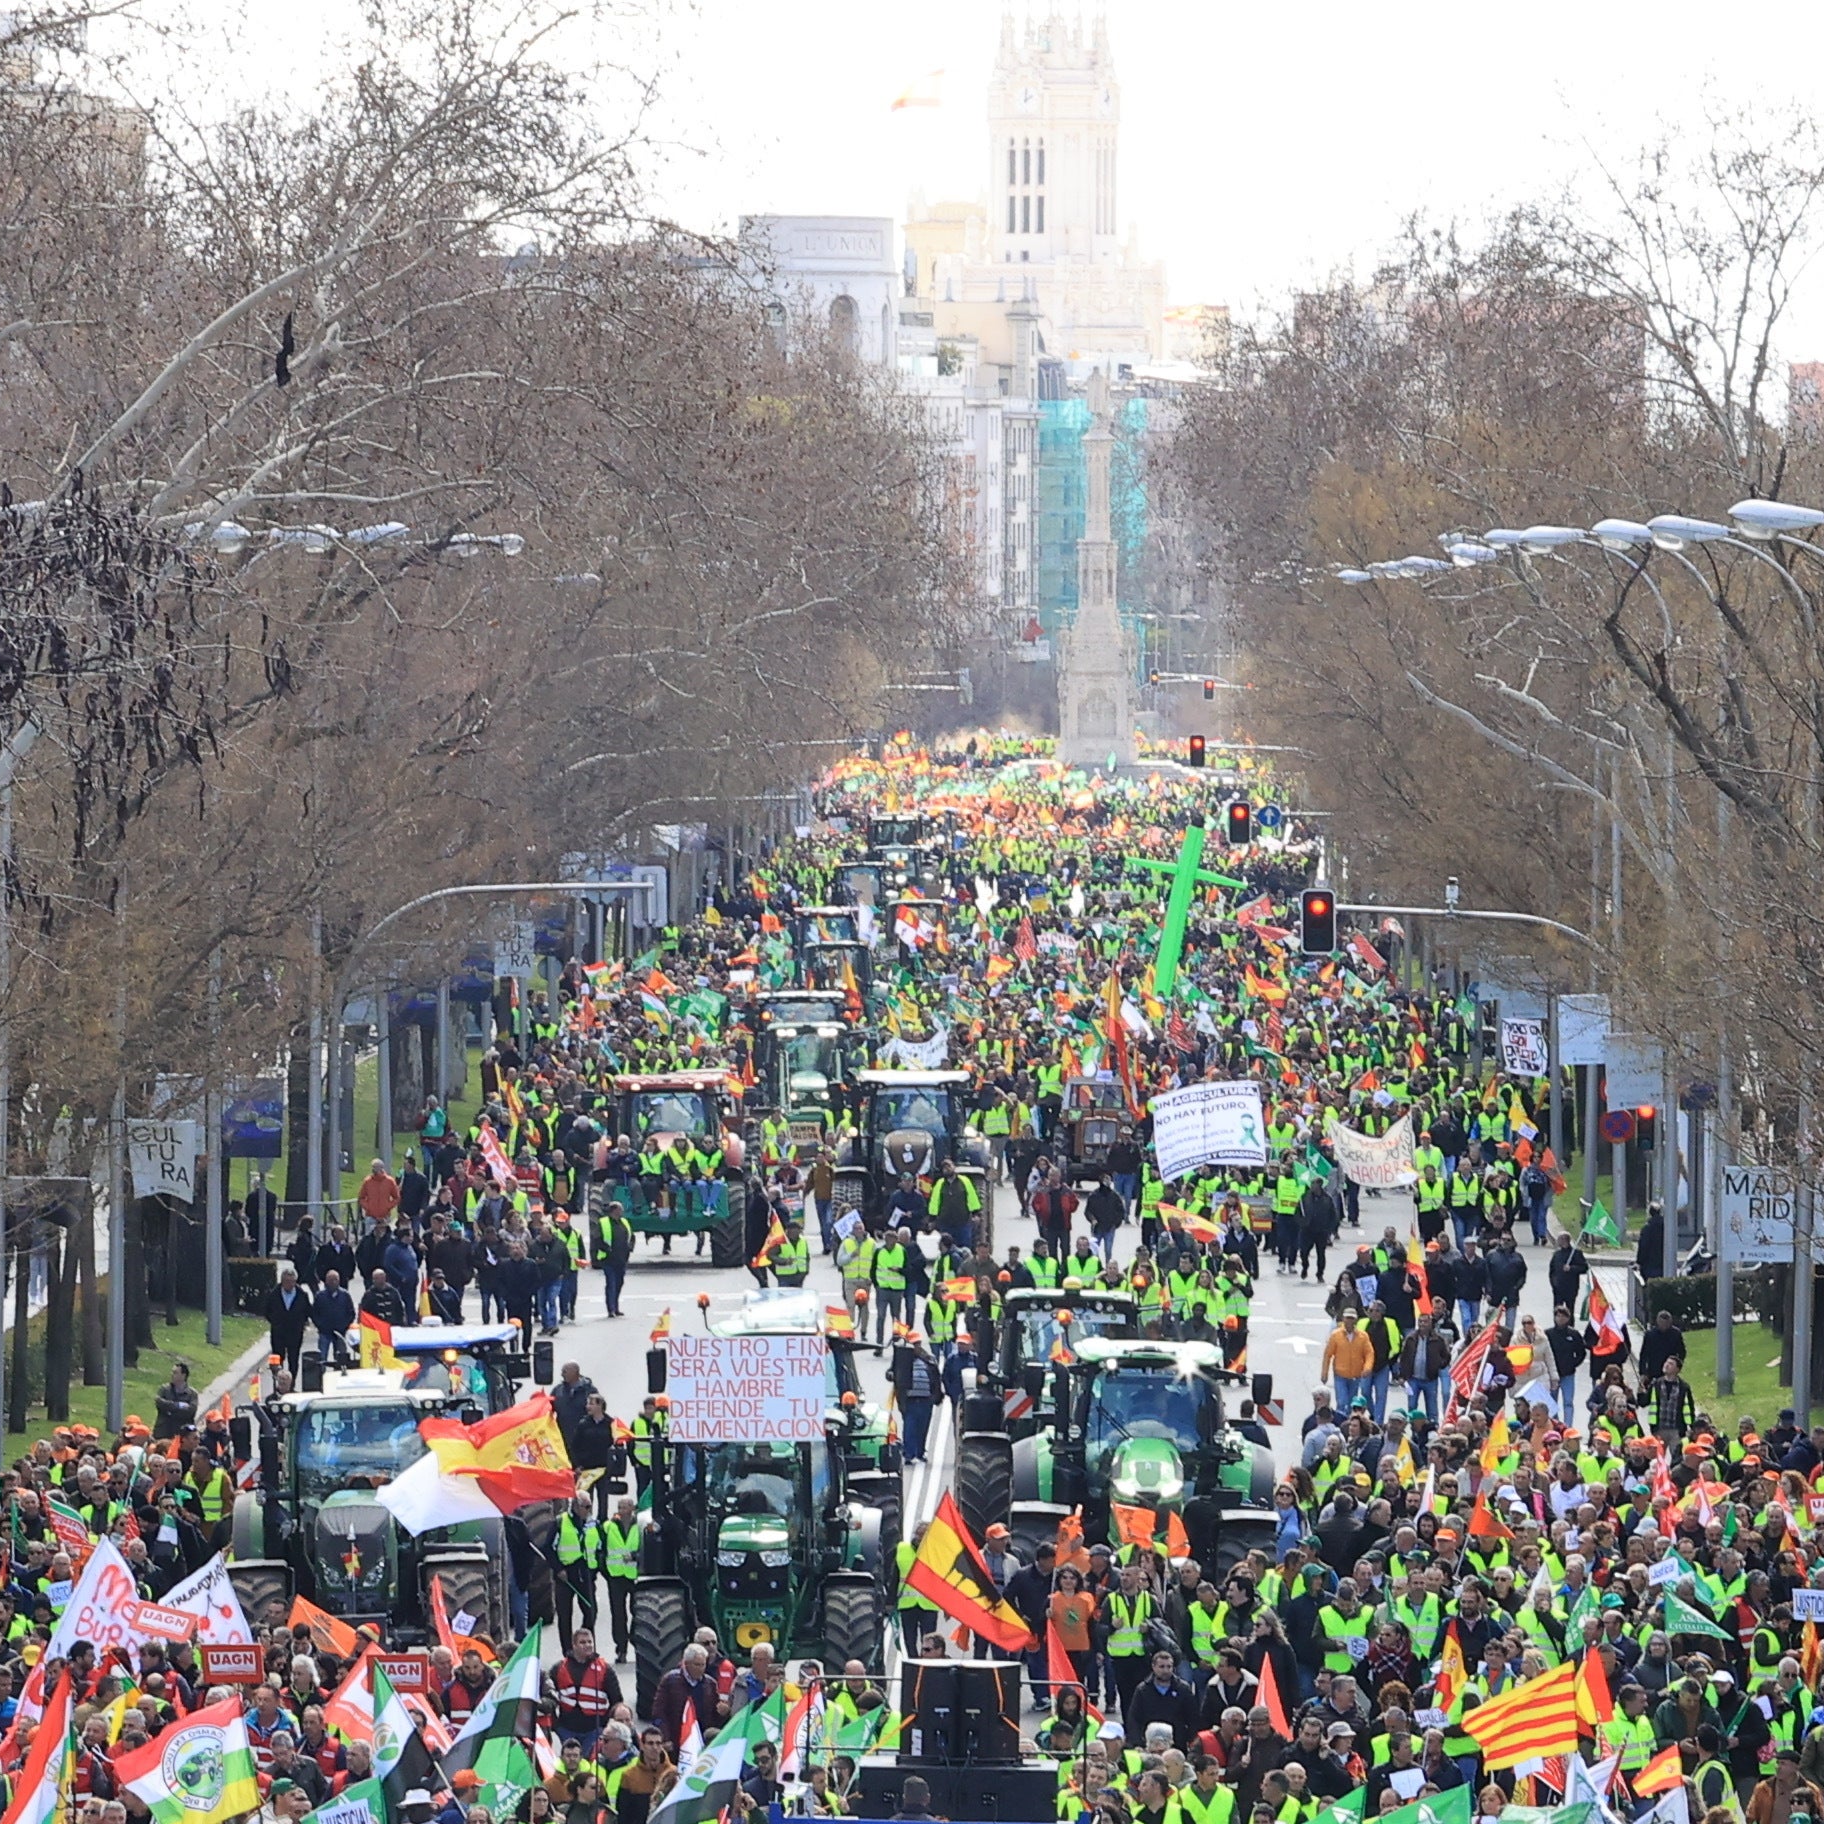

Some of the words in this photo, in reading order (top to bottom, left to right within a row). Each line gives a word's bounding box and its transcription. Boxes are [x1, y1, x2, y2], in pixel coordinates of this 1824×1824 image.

[1173, 1108, 1197, 1121] HAY
[143, 1144, 175, 1161] TU
[159, 1162, 191, 1188] RA
[1748, 1196, 1791, 1220] RID
[669, 1338, 770, 1357] NUESTRO
[786, 1338, 824, 1356] FIN
[669, 1359, 722, 1377] SERA
[730, 1358, 825, 1377] VUESTRA
[695, 1378, 785, 1397] HAMBRE
[670, 1399, 765, 1418] DEFIENDE
[788, 1398, 819, 1417] TU
[670, 1419, 825, 1439] ALIMENTACION
[141, 1608, 188, 1632] UAGN
[209, 1651, 254, 1668] UAGN
